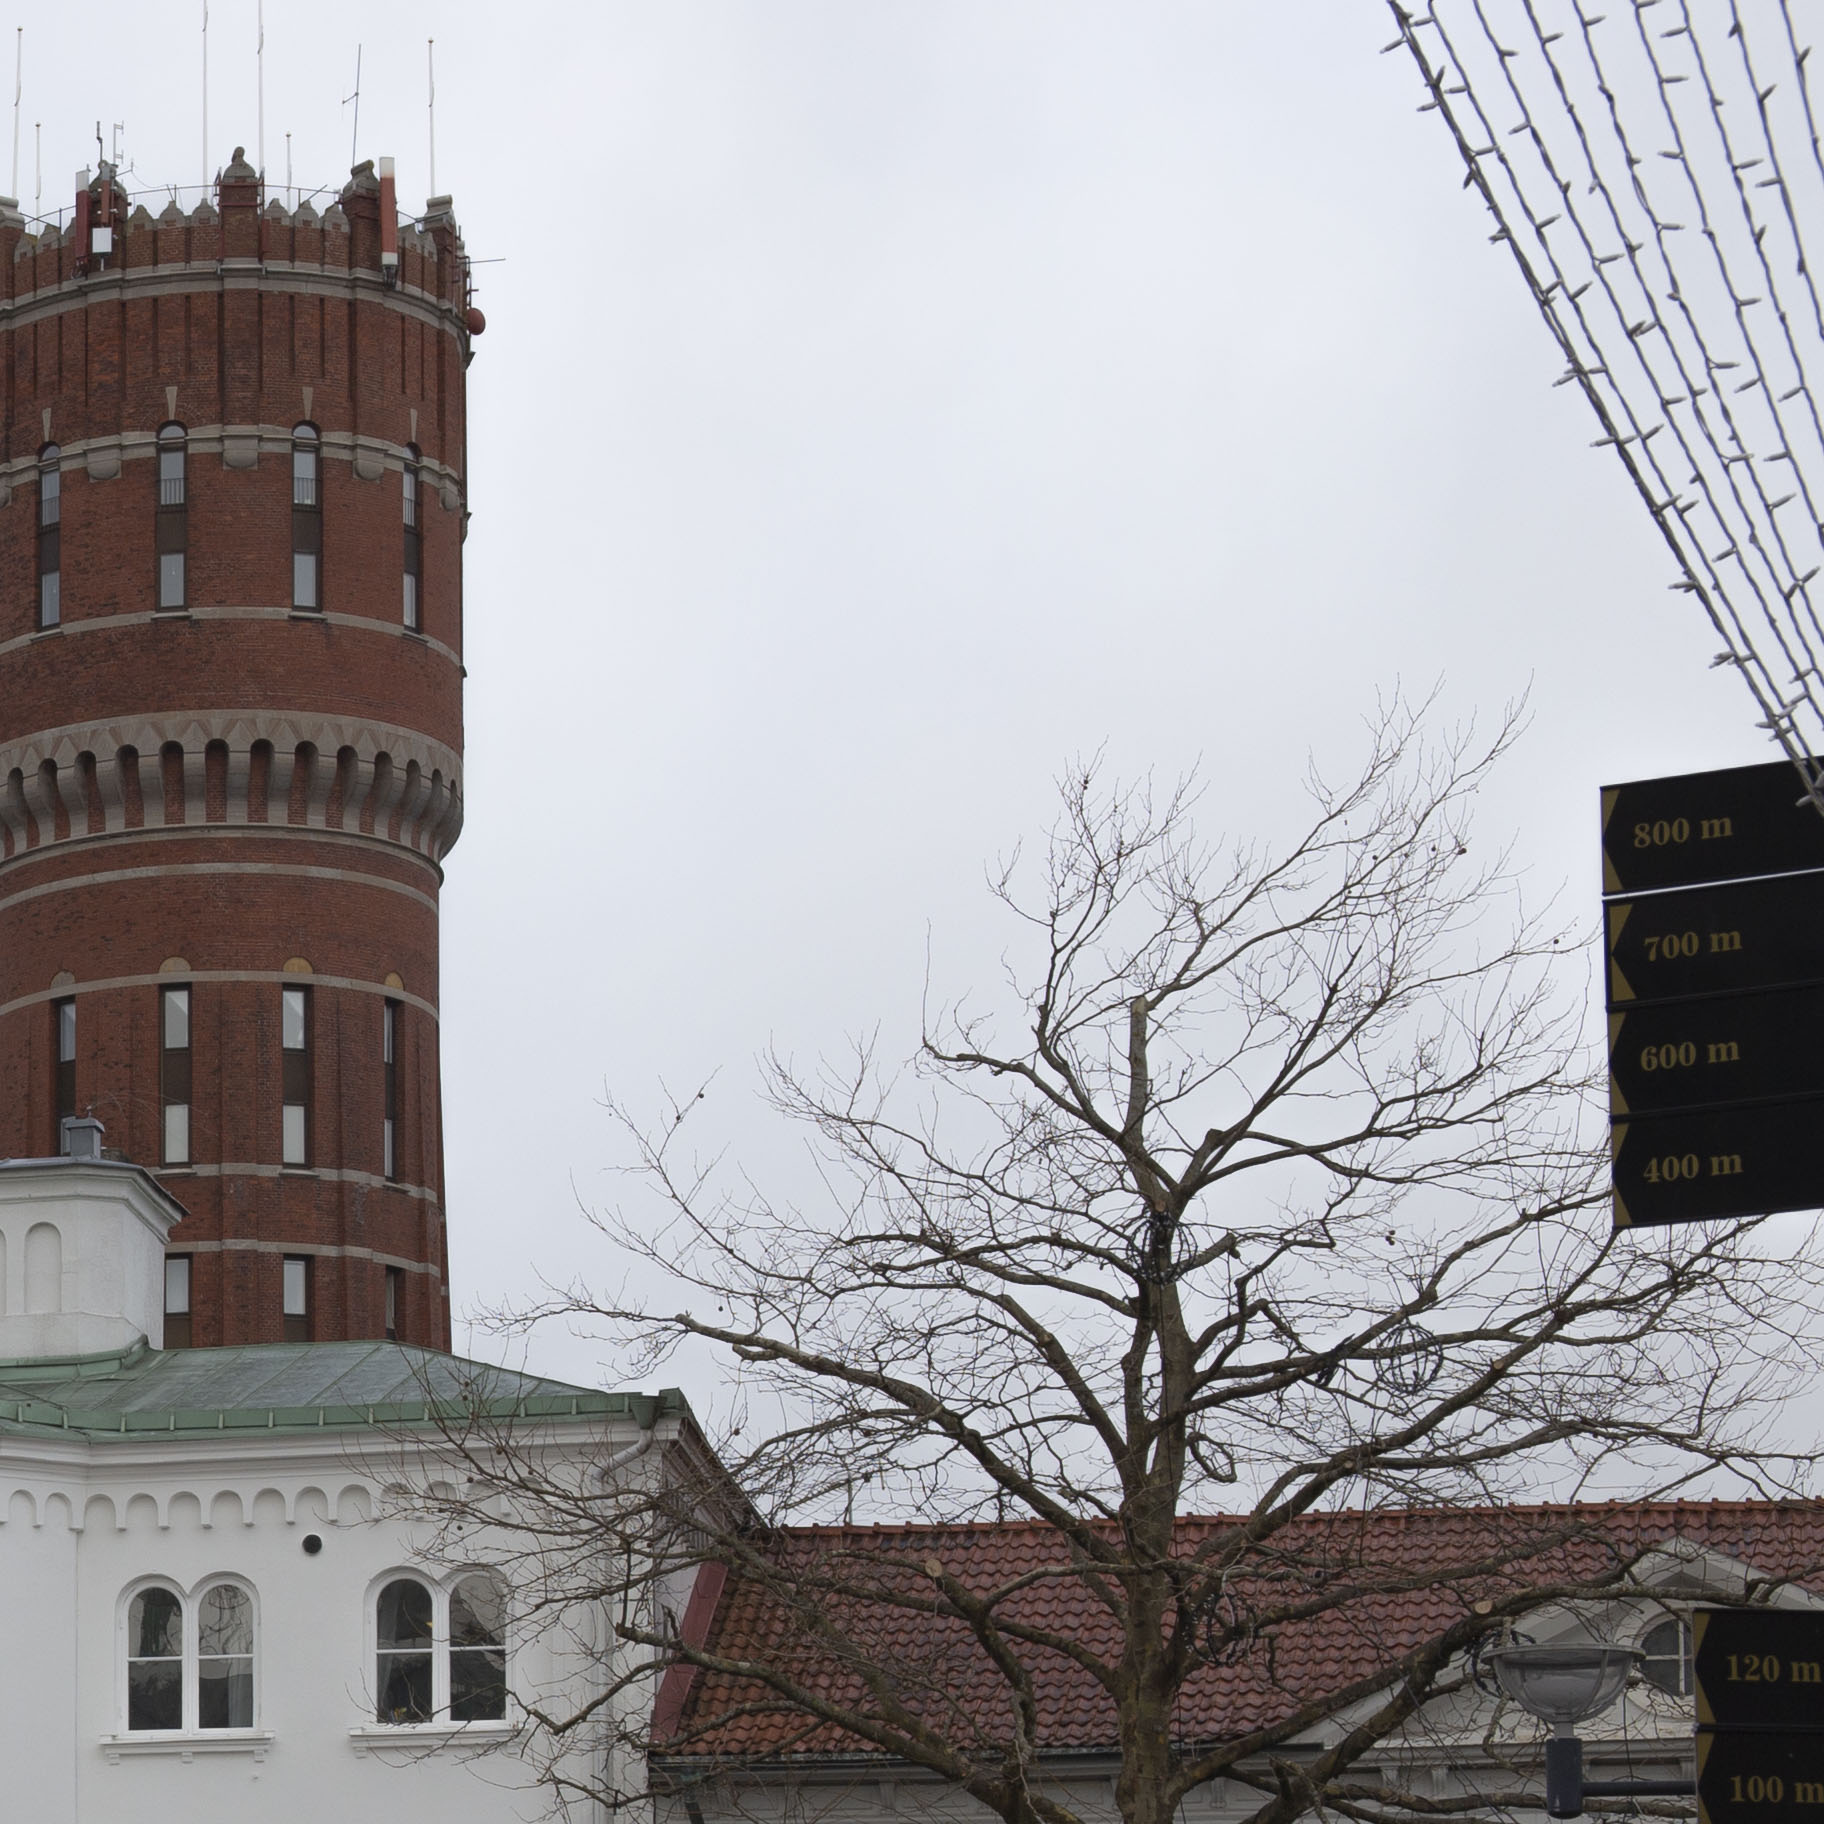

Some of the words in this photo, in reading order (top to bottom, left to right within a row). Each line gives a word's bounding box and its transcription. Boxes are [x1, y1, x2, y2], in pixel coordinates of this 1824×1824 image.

[1633, 817, 1691, 848] 800
[1700, 816, 1733, 840] m
[1643, 931, 1700, 962] 700
[1709, 930, 1743, 952] m
[1640, 1041, 1697, 1072] 600
[1707, 1040, 1741, 1064] m
[1642, 1153, 1700, 1184] 400
[1710, 1153, 1744, 1177] m
[1726, 1654, 1780, 1682] 120
[1790, 1661, 1822, 1683] m
[1730, 1775, 1784, 1803] 100
[1795, 1781, 1824, 1804] m
